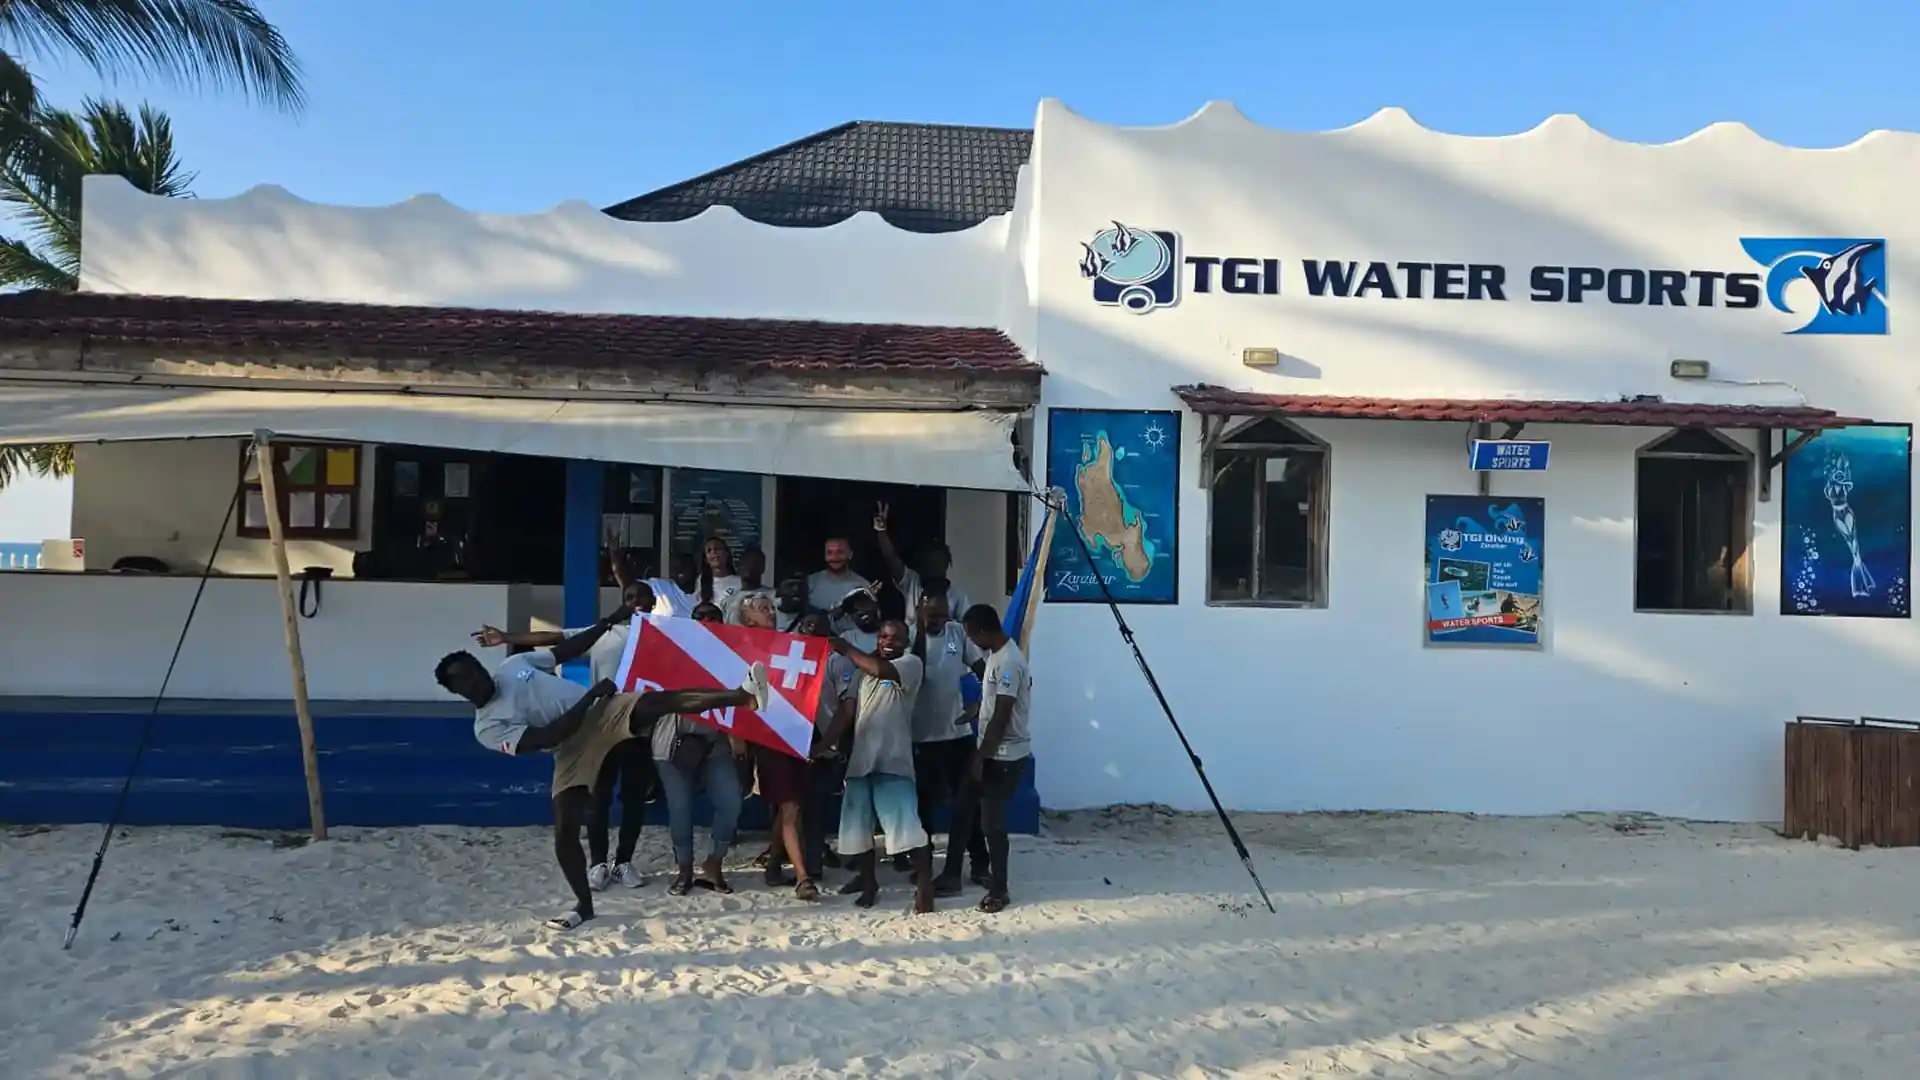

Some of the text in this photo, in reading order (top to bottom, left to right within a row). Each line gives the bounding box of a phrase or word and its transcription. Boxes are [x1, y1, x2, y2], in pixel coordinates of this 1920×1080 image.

[1185, 256, 1762, 309] TGI WATER SPORTS
[1496, 445, 1531, 456] WATER
[1491, 457, 1531, 469] SPORTS
[1485, 534, 1525, 545] Diving
[1442, 615, 1504, 628] WATER SPORTS
